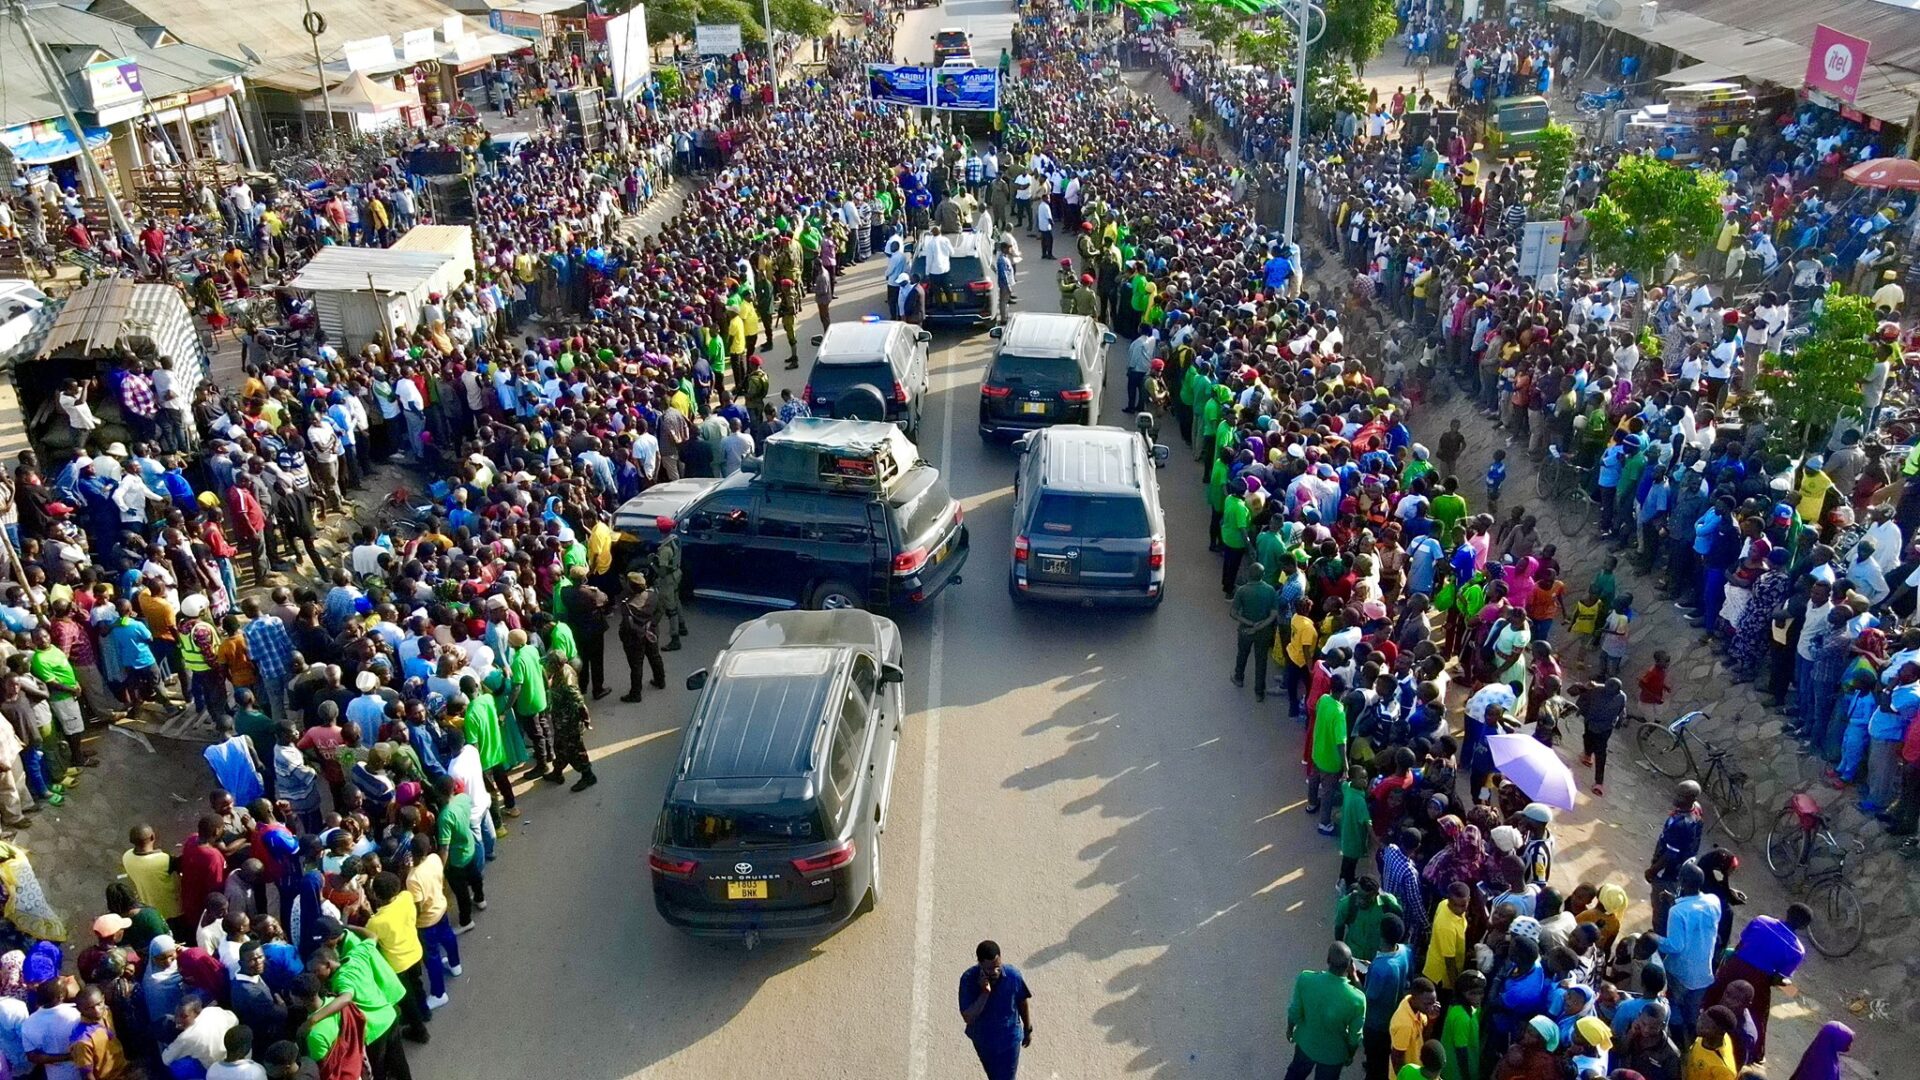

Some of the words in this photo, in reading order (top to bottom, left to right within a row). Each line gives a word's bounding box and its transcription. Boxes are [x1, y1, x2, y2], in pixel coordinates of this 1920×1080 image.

[1828, 51, 1848, 73] itel
[893, 72, 924, 82] KARIBU
[963, 74, 994, 83] KARIBU
[742, 889, 758, 898] BNK
